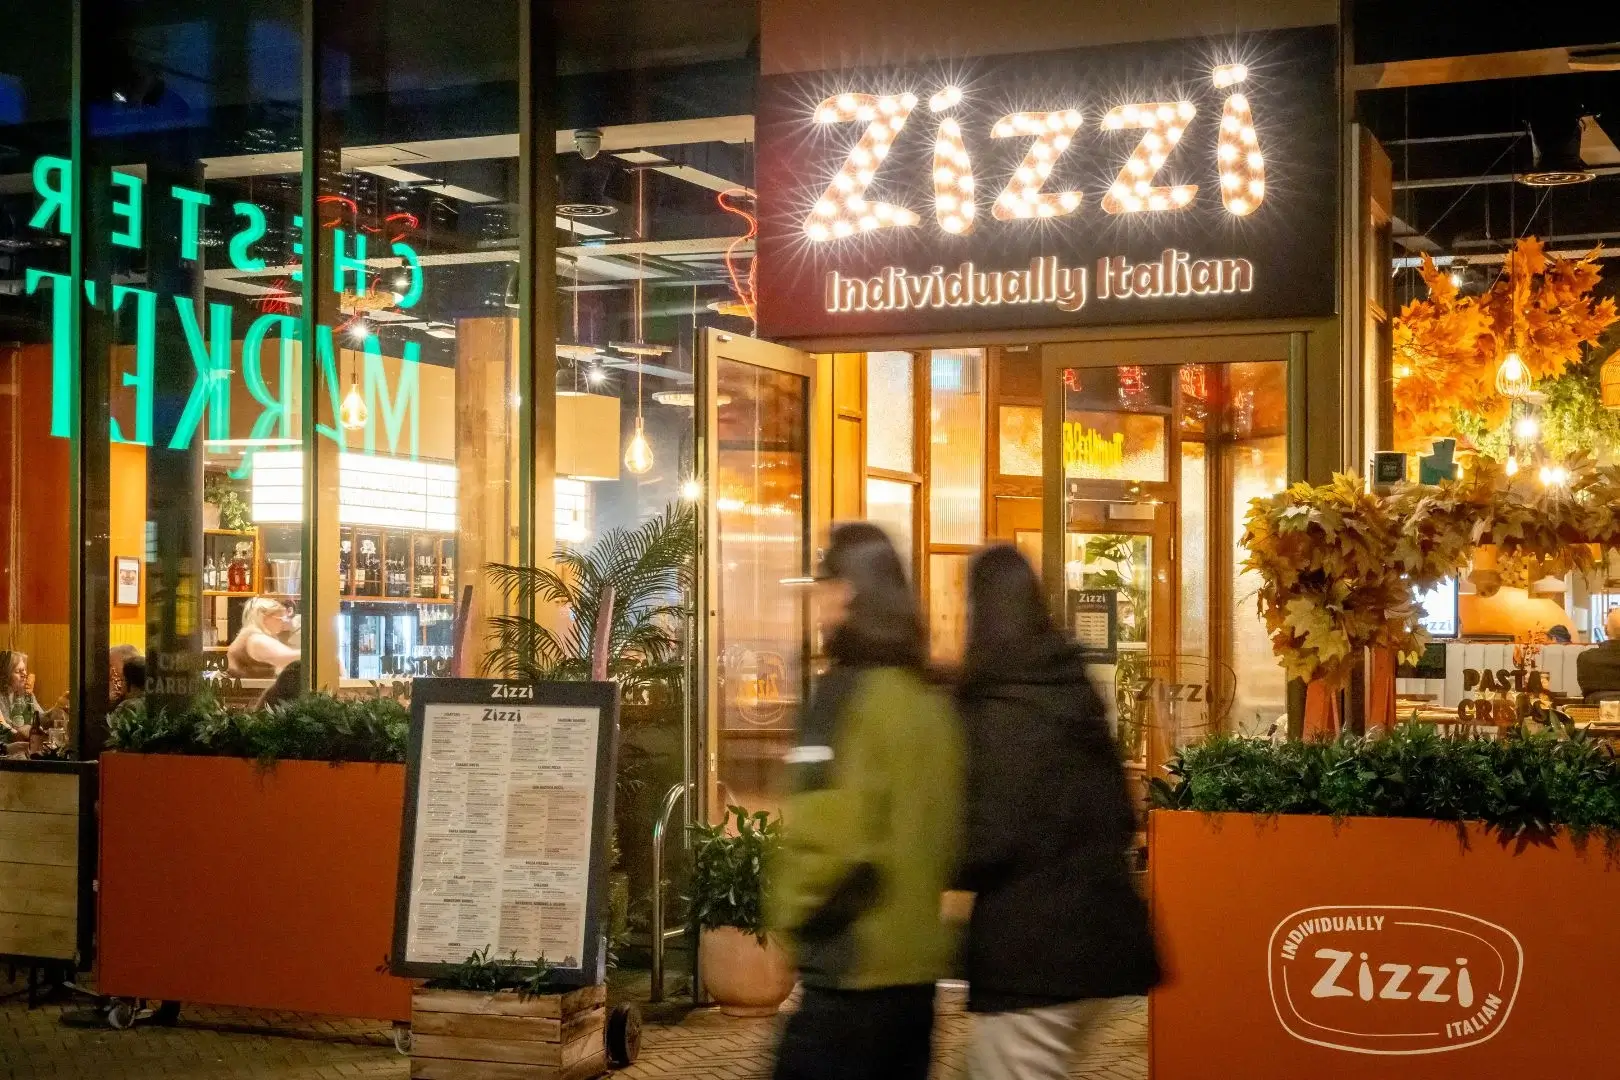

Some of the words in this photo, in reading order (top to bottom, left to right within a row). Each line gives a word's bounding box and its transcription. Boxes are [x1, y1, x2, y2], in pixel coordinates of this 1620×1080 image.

[803, 63, 1265, 242] Zizzi
[825, 254, 1086, 312] Individually
[1096, 248, 1254, 300] Italian
[1078, 593, 1106, 603] Zizzi
[490, 683, 534, 699] Zizzi
[1134, 676, 1213, 705] Zizzi
[1462, 668, 1545, 692] PASTA
[481, 708, 522, 722] Zizzi
[1280, 915, 1385, 961] INDIVIDUALLY
[1310, 948, 1474, 1008] Zizzi
[1445, 993, 1502, 1038] ITALIAN
